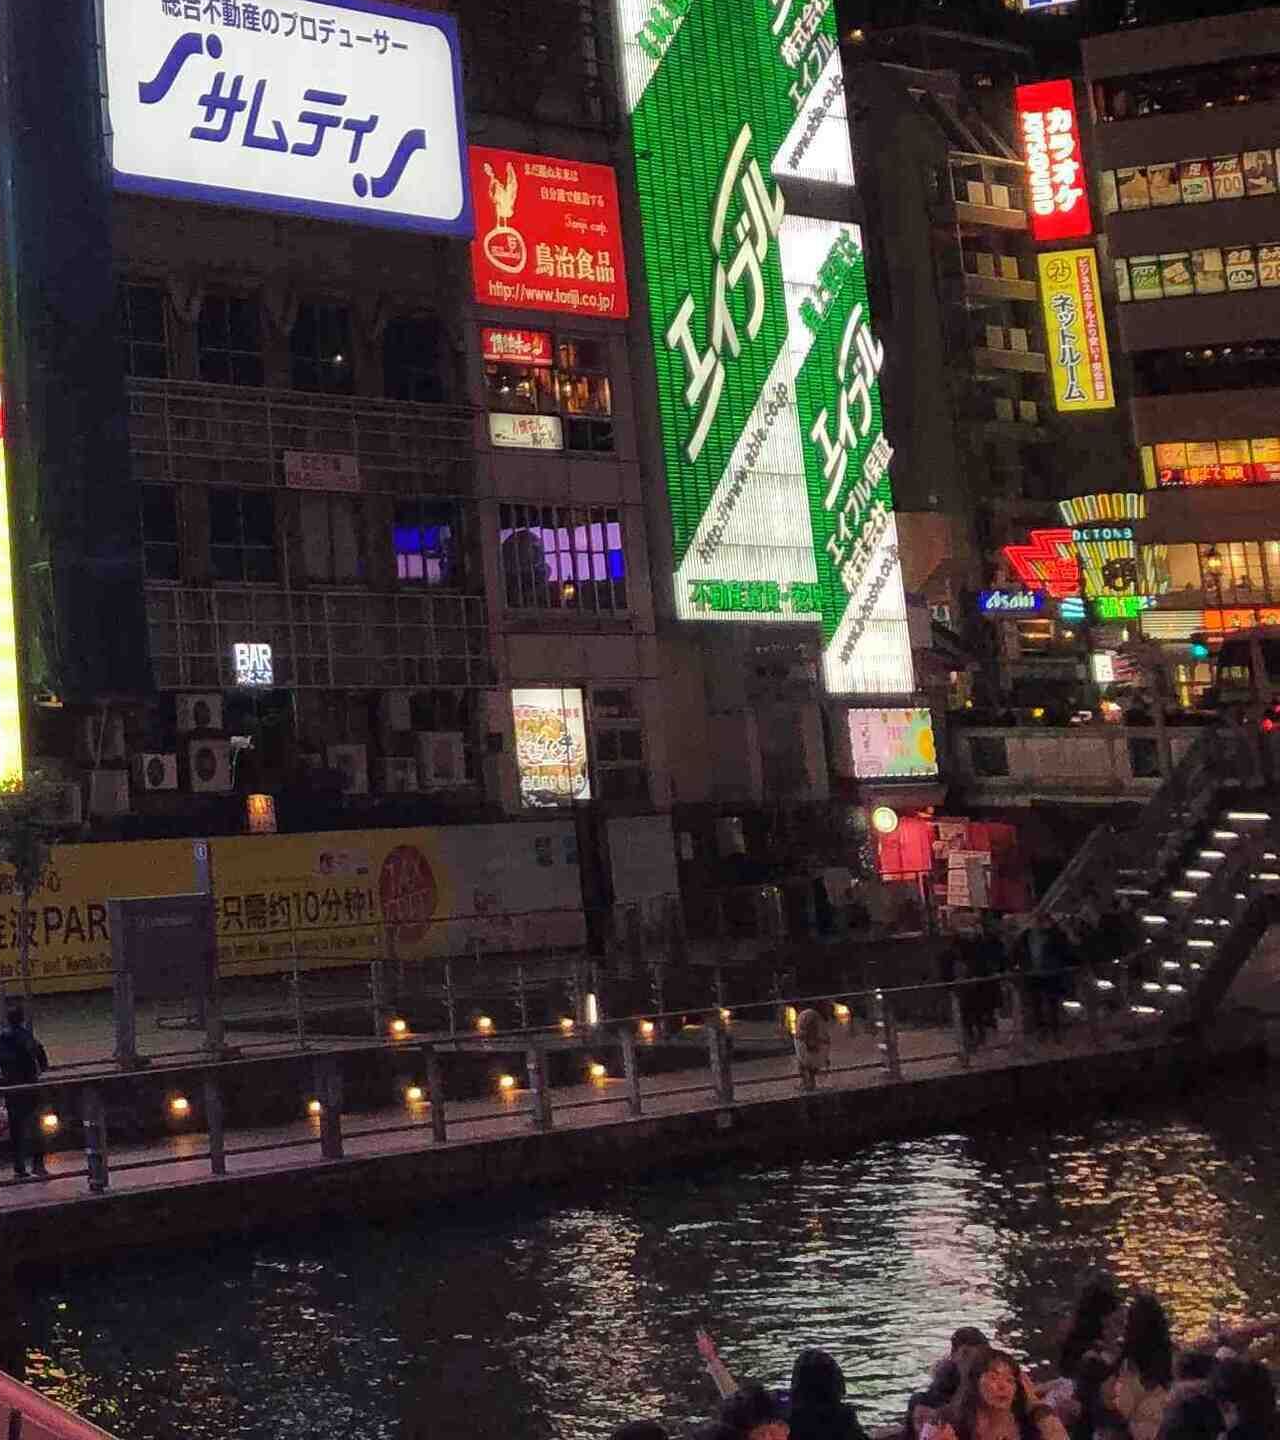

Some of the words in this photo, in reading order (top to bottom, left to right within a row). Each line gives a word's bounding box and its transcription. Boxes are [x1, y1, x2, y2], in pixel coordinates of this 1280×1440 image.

[190, 71, 379, 163] サムティ
[1046, 107, 1082, 213] カラオケ
[1052, 294, 1088, 404] ネットルーム
[985, 591, 1036, 609] Asahi
[235, 643, 272, 671] BAR
